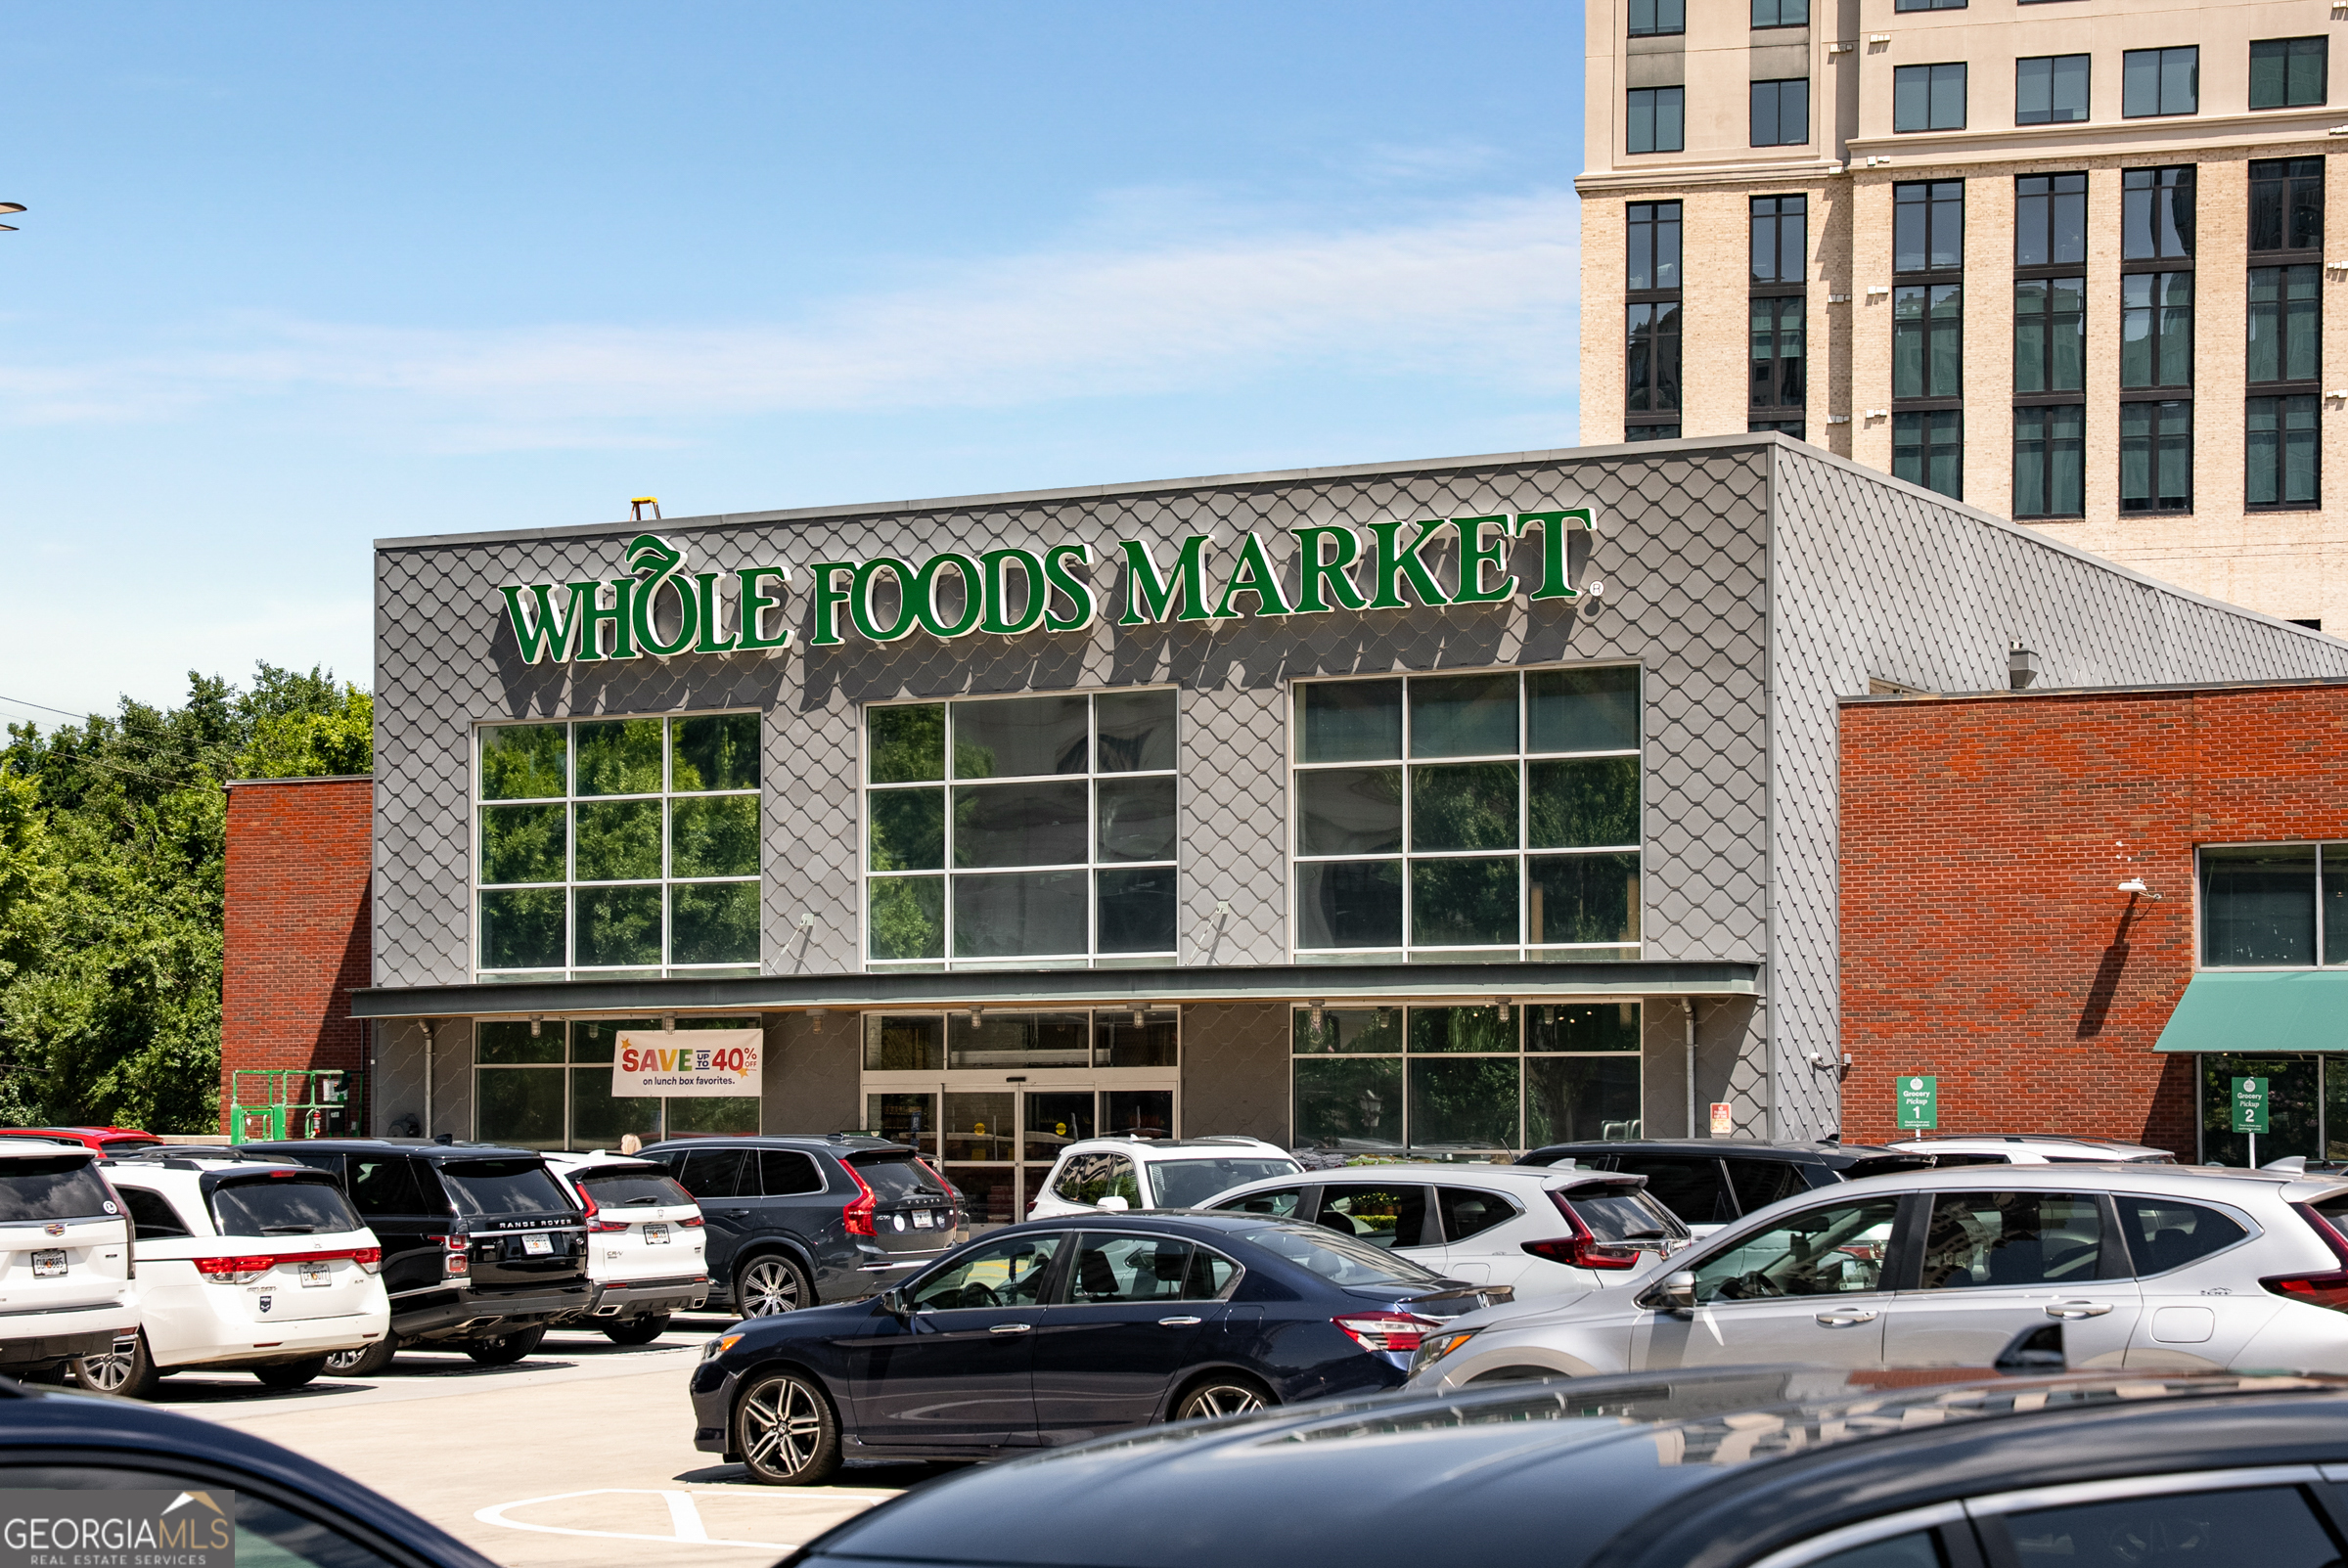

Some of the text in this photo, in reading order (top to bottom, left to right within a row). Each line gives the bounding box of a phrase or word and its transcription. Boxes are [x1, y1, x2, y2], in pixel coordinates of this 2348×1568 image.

[496, 533, 795, 665] WHOLE
[809, 543, 1098, 647] FOODS
[1118, 507, 1598, 626] MARKET
[621, 1049, 694, 1072] SAVE
[696, 1076, 736, 1085] favorites.
[1913, 1106, 1919, 1119] 1
[2245, 1109, 2254, 1122] 2
